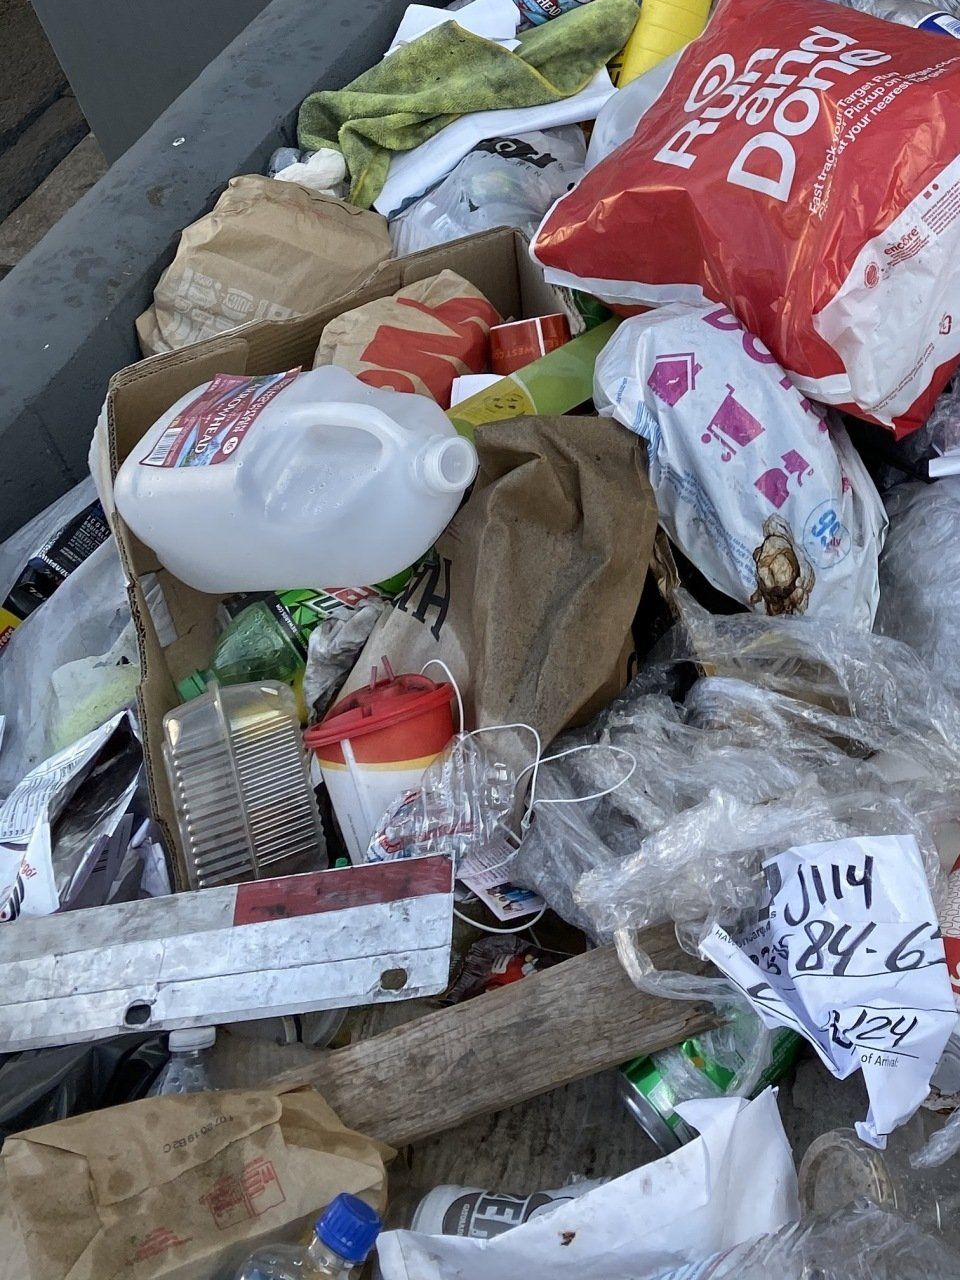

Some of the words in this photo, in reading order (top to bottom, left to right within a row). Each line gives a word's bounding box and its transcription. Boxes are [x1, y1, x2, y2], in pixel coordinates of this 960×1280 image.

[653, 48, 781, 169] Run
[736, 25, 859, 125] and
[836, 138, 848, 155] at
[845, 114, 872, 143] your
[871, 80, 914, 116] nearest
[844, 86, 885, 119] Pickup
[884, 74, 902, 86] on
[727, 49, 892, 202] Done
[809, 183, 824, 214] Fast
[818, 144, 837, 181] track
[837, 80, 876, 108] Target
[860, 1052, 874, 1063] of
